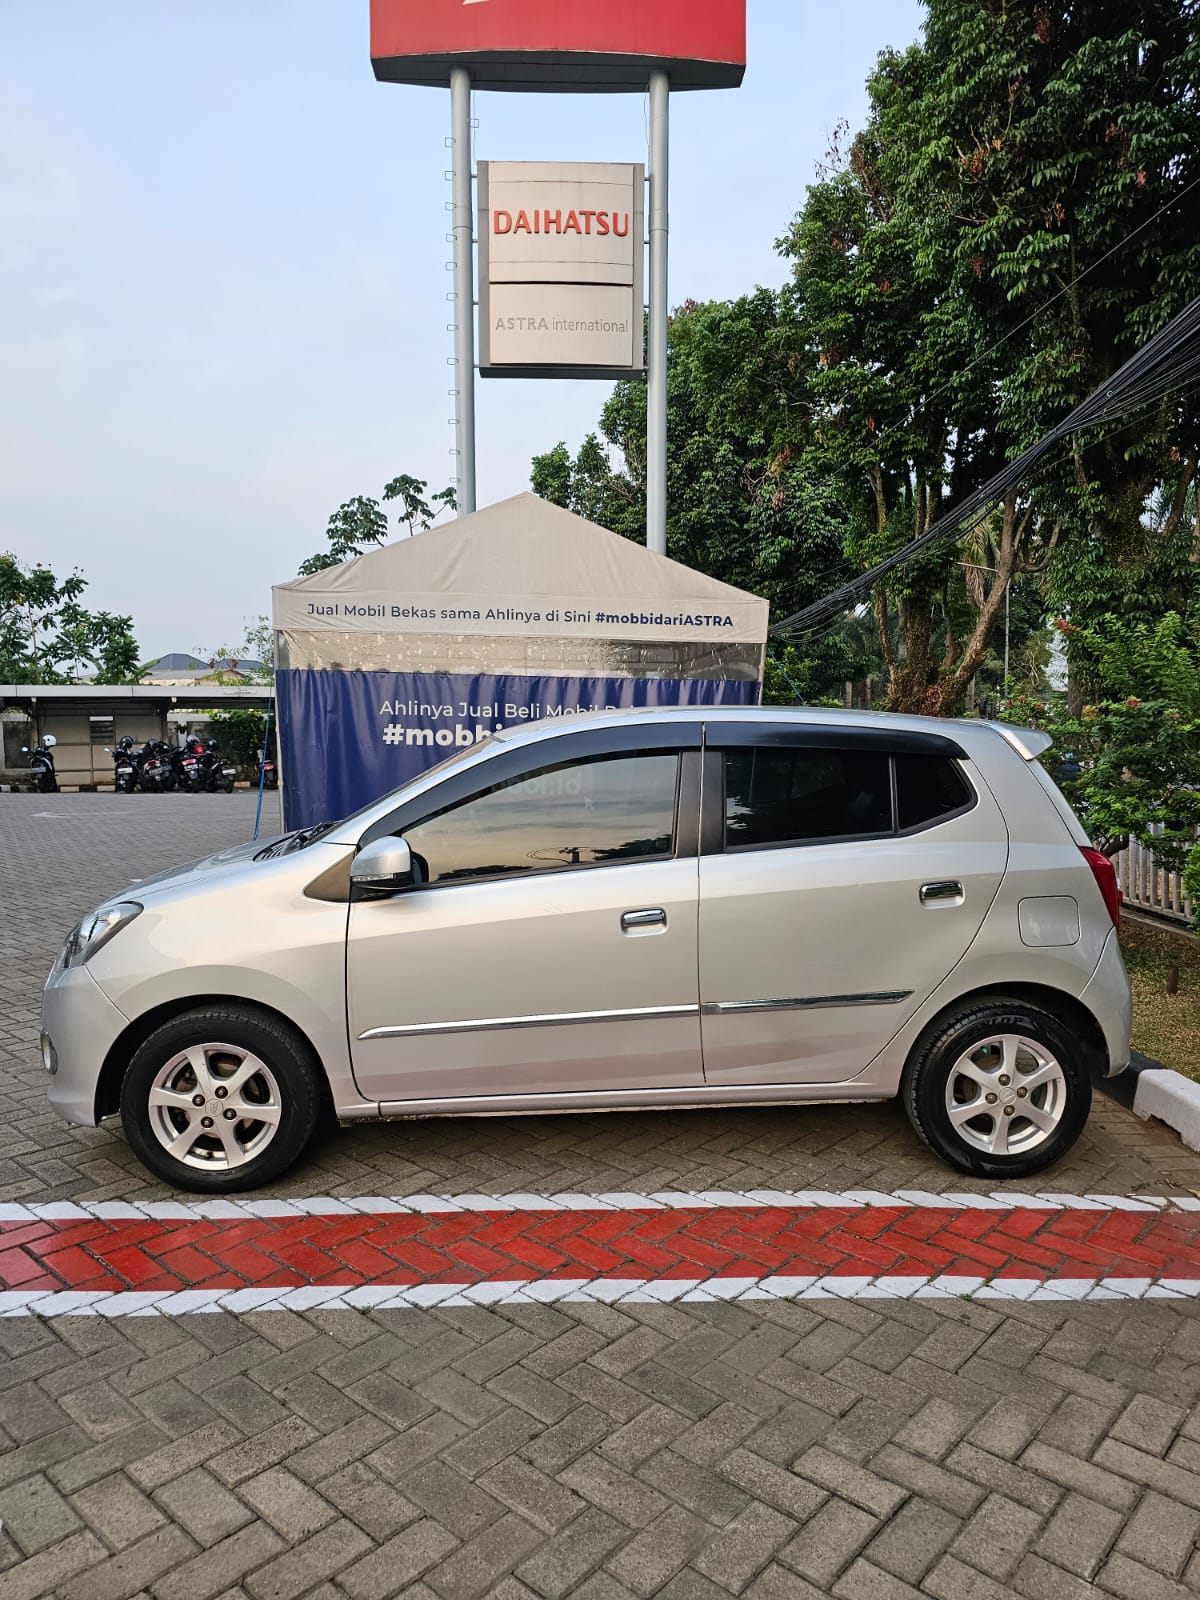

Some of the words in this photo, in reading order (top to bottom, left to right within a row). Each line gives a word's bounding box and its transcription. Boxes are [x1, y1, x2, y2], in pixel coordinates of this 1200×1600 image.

[493, 209, 629, 237] DAIHATSU
[495, 317, 549, 331] ASTRA
[551, 316, 628, 333] international
[307, 603, 339, 616] Jual
[344, 604, 386, 617] Mobil
[391, 606, 437, 618] Bekas
[440, 608, 481, 620] sama
[485, 608, 541, 624] Ahlinya
[545, 610, 559, 622] di
[564, 611, 591, 623] Sini
[595, 612, 734, 627] #mobbidariASTRA
[379, 700, 453, 720] Ahlinya
[458, 702, 499, 718] Jual
[504, 703, 540, 719] Beli
